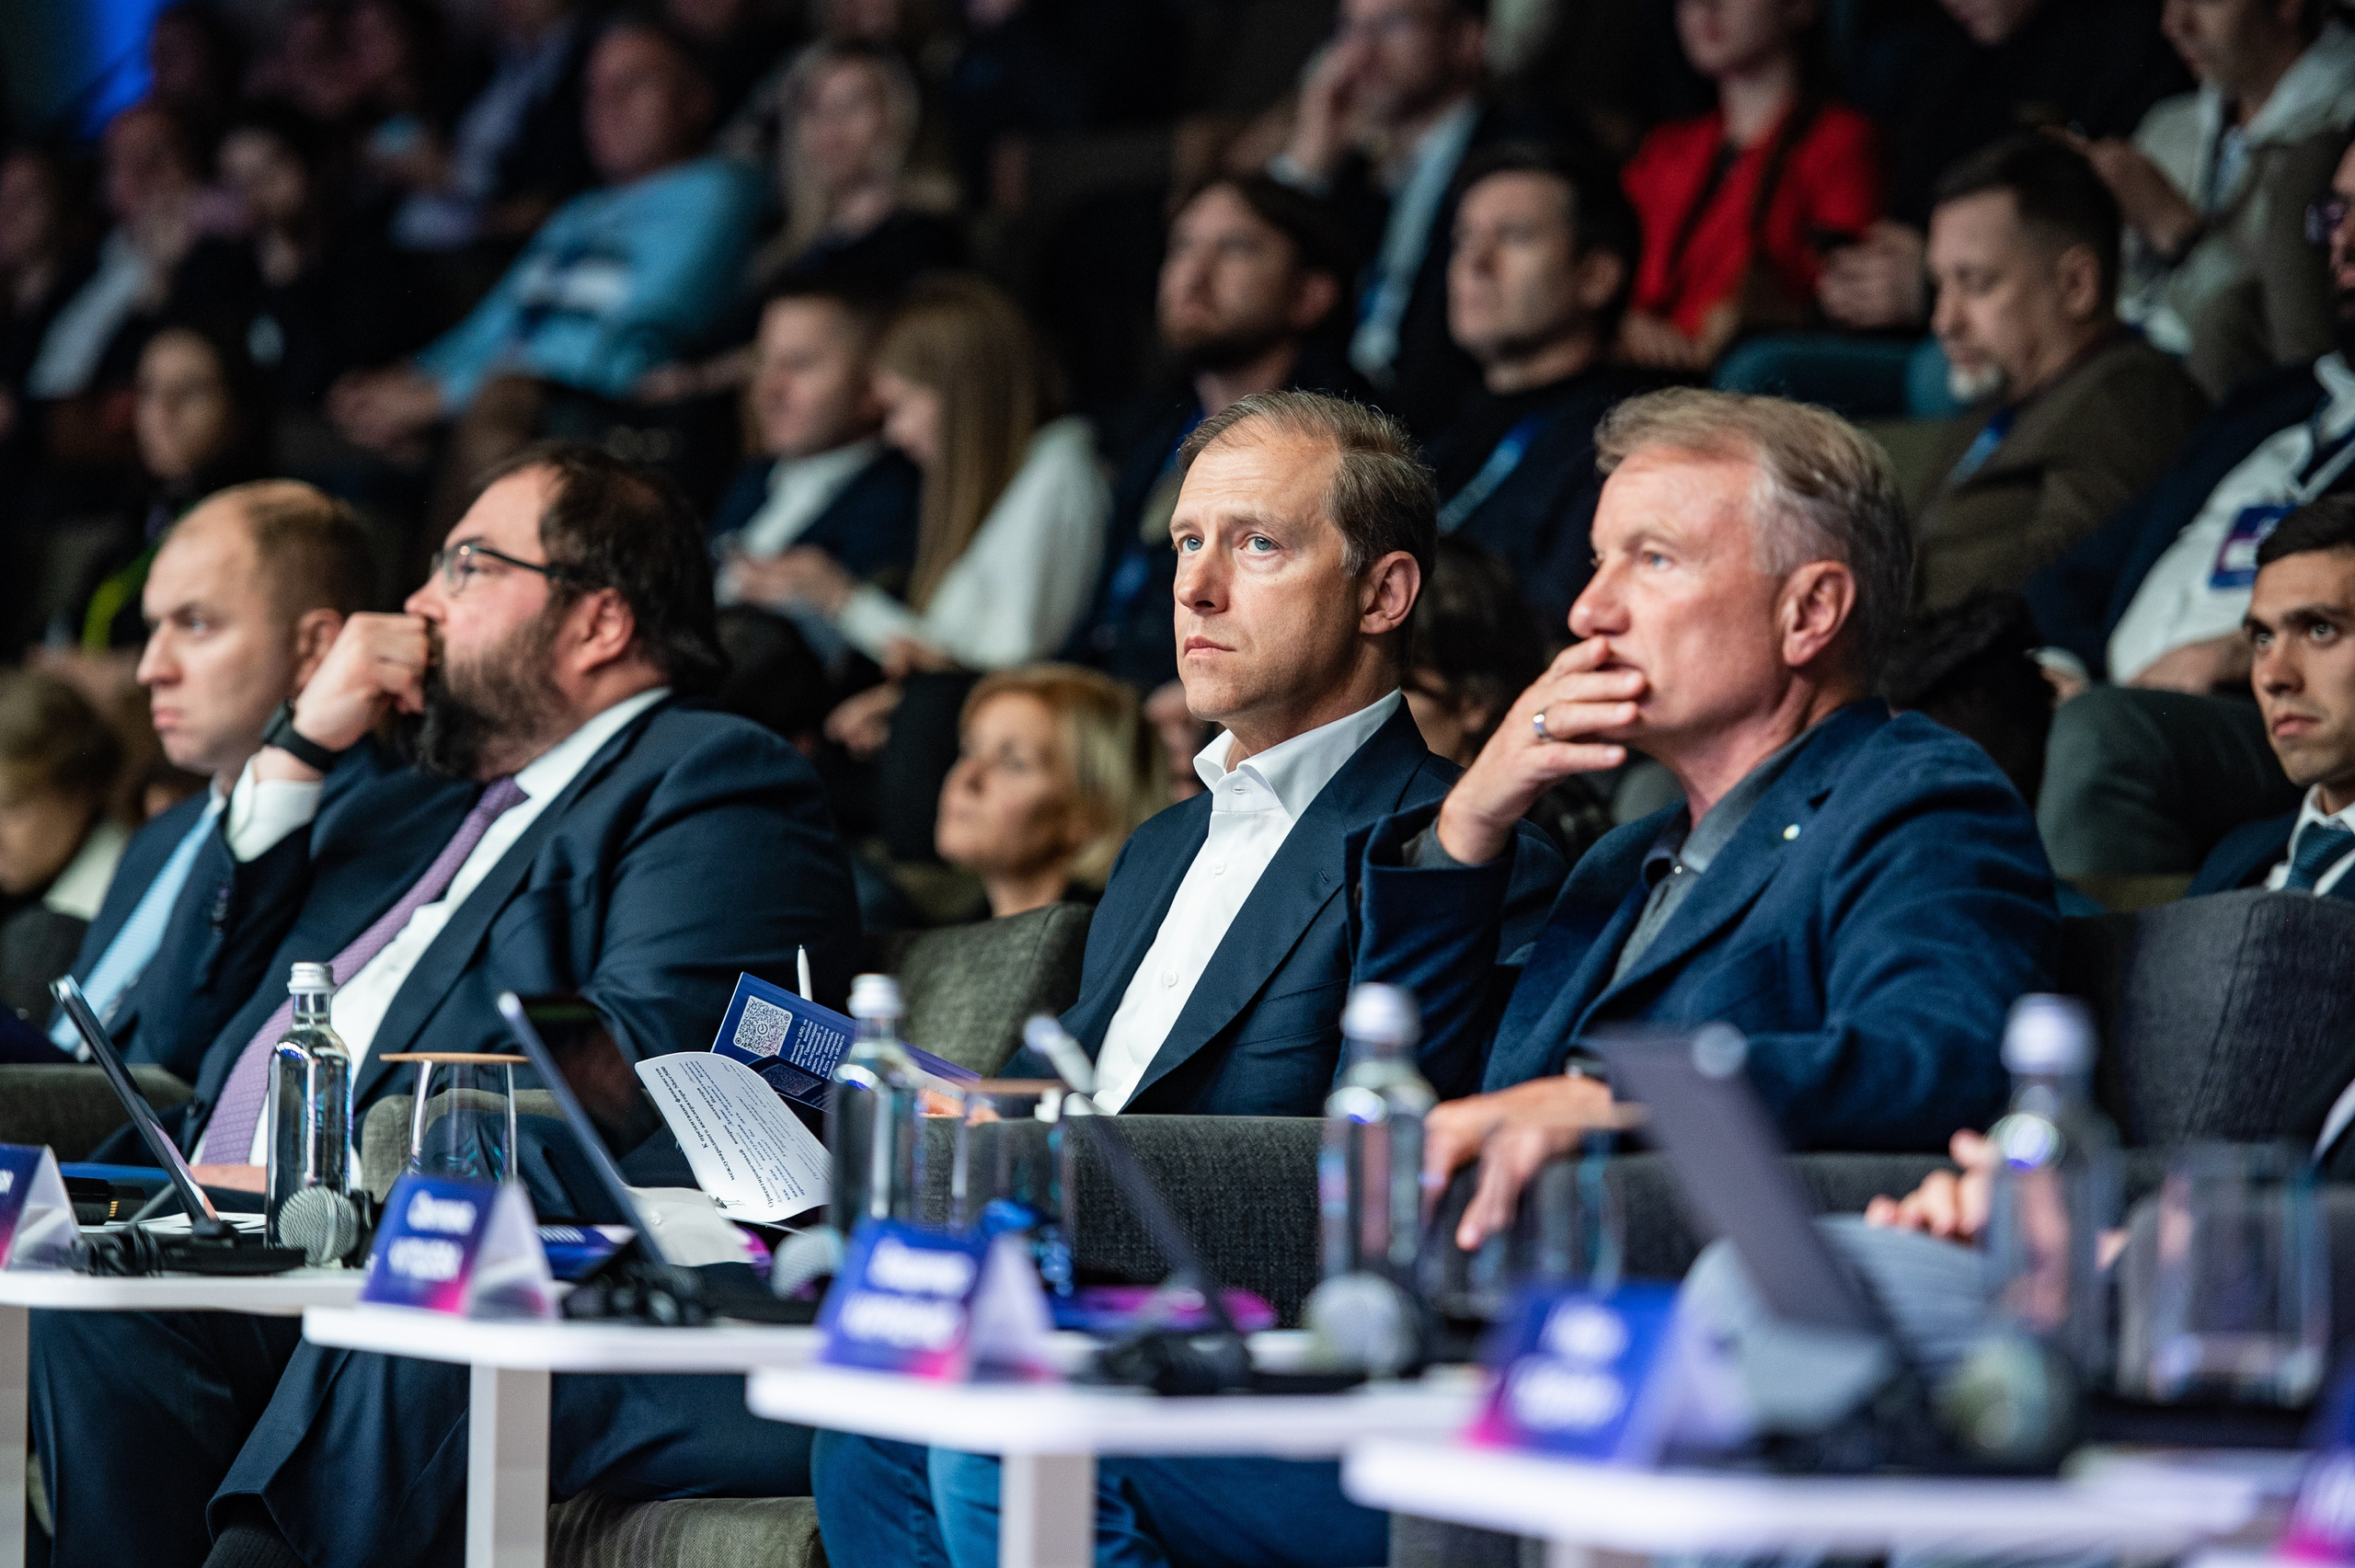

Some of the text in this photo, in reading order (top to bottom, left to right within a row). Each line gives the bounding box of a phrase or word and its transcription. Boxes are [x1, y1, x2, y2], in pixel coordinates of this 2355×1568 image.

[789, 1038, 801, 1062] альности
[816, 1054, 826, 1075] актного
[655, 1069, 680, 1103] финалистов
[697, 1089, 721, 1119] модератора
[719, 1110, 734, 1126] Денис
[661, 1068, 734, 1181] международного акселератора Sber500
[679, 1104, 705, 1142] презентации
[723, 1125, 738, 1144] вопрос
[738, 1125, 765, 1161] выступления
[739, 1149, 775, 1207] Ориентировочный
[769, 1170, 778, 1180] вам
[775, 1166, 798, 1197] напутствие
